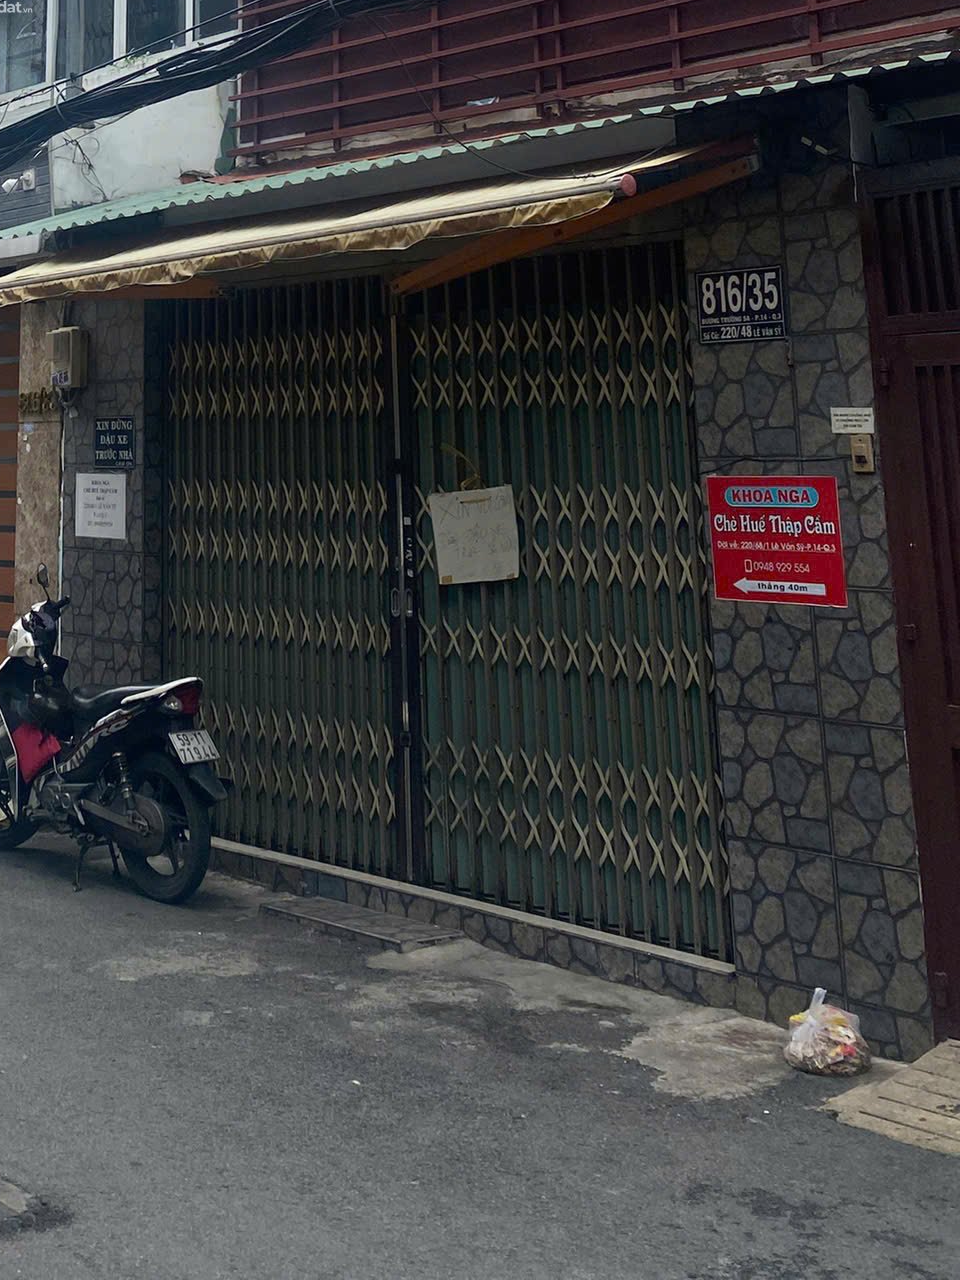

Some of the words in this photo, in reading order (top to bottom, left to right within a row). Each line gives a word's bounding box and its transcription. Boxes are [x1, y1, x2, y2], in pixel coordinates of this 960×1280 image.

[702, 272, 779, 314] 816/35
[720, 325, 753, 339] 220/48
[95, 420, 110, 430] XIN
[117, 435, 129, 445] XE
[732, 489, 774, 503] KHOA
[777, 489, 811, 504] NGA
[714, 514, 738, 532] Chè
[740, 514, 766, 532] Huế
[768, 515, 802, 537] Thập
[753, 562, 774, 572] 0948
[775, 563, 793, 573] 929
[793, 563, 811, 574] 554
[787, 584, 809, 593] 40m
